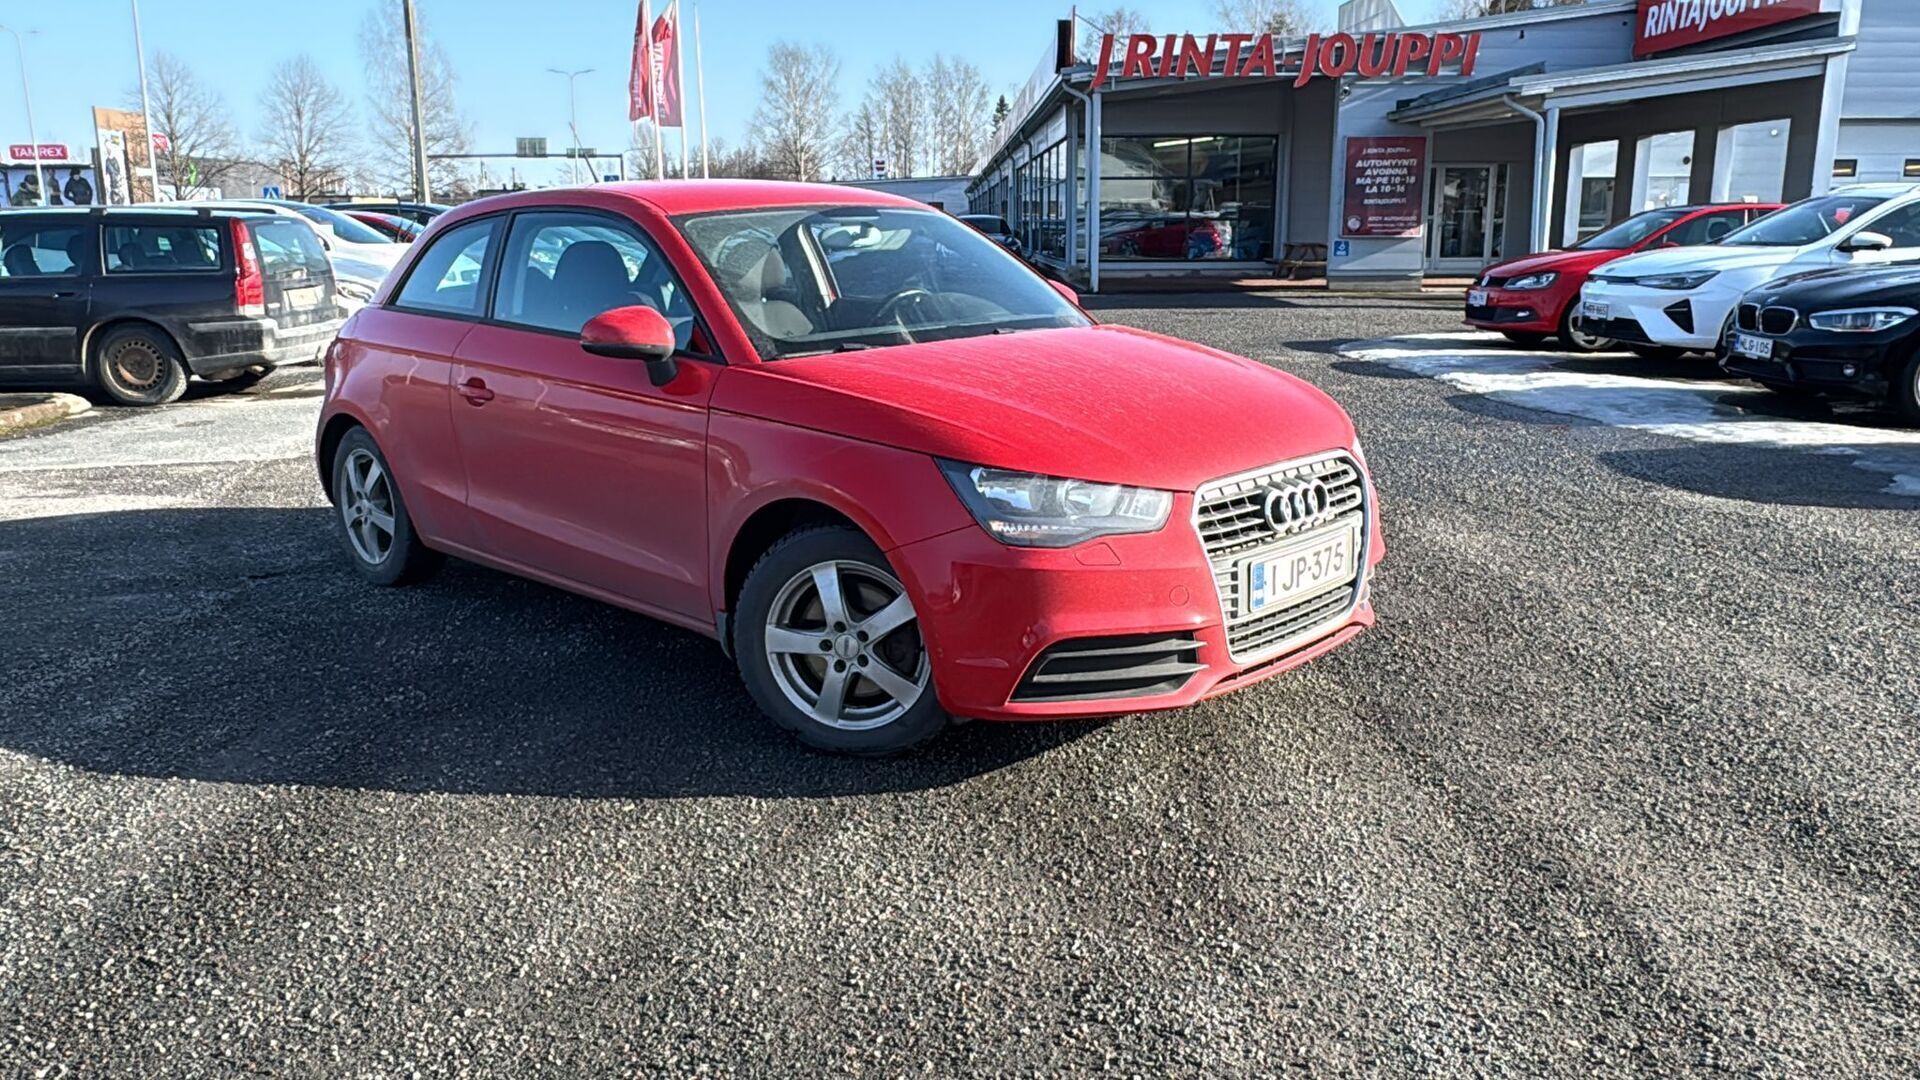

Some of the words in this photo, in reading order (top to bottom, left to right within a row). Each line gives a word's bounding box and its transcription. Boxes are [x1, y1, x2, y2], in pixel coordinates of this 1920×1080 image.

[1090, 33, 1115, 89] J
[1122, 32, 1482, 88] RINTA-JOUPPI
[13, 146, 64, 158] TAMREX
[1355, 158, 1417, 168] AUTOMYYNTI
[1364, 168, 1409, 176] AVOINNA
[1355, 176, 1389, 185] MA-PE
[1390, 176, 1416, 184] 10-18
[1364, 185, 1378, 193] LA
[1380, 185, 1406, 193] 10-16
[1271, 541, 1344, 596] IJP-375
